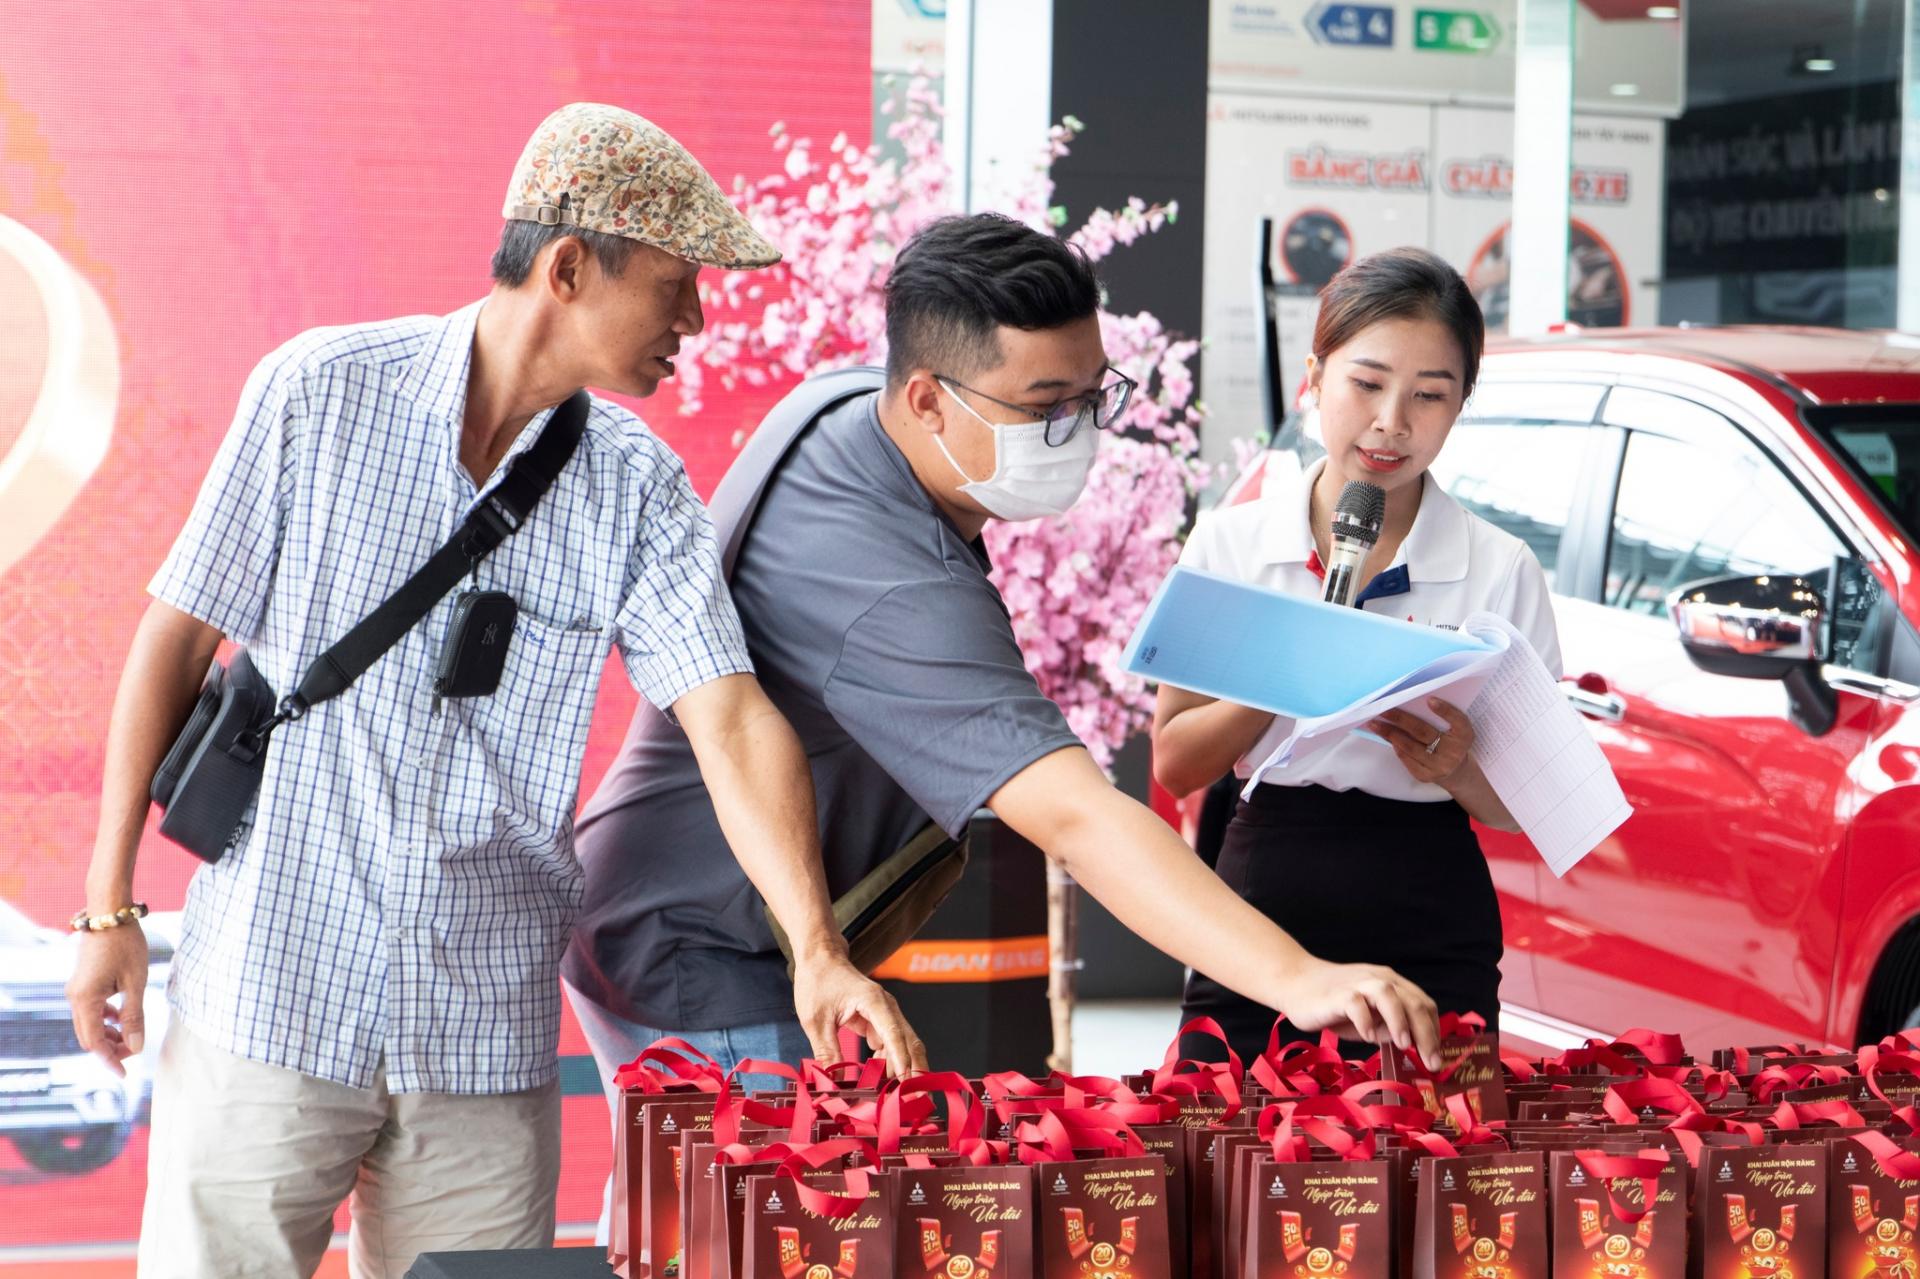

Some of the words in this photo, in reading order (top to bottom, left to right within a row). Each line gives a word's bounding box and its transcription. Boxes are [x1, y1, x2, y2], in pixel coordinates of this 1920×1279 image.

[1101, 1172, 1120, 1180] XUÂN
[1120, 1170, 1134, 1180] RỘN
[962, 1183, 982, 1191] XUÂN
[984, 1182, 998, 1192] RỘN
[1000, 1182, 1020, 1190] RÀNG
